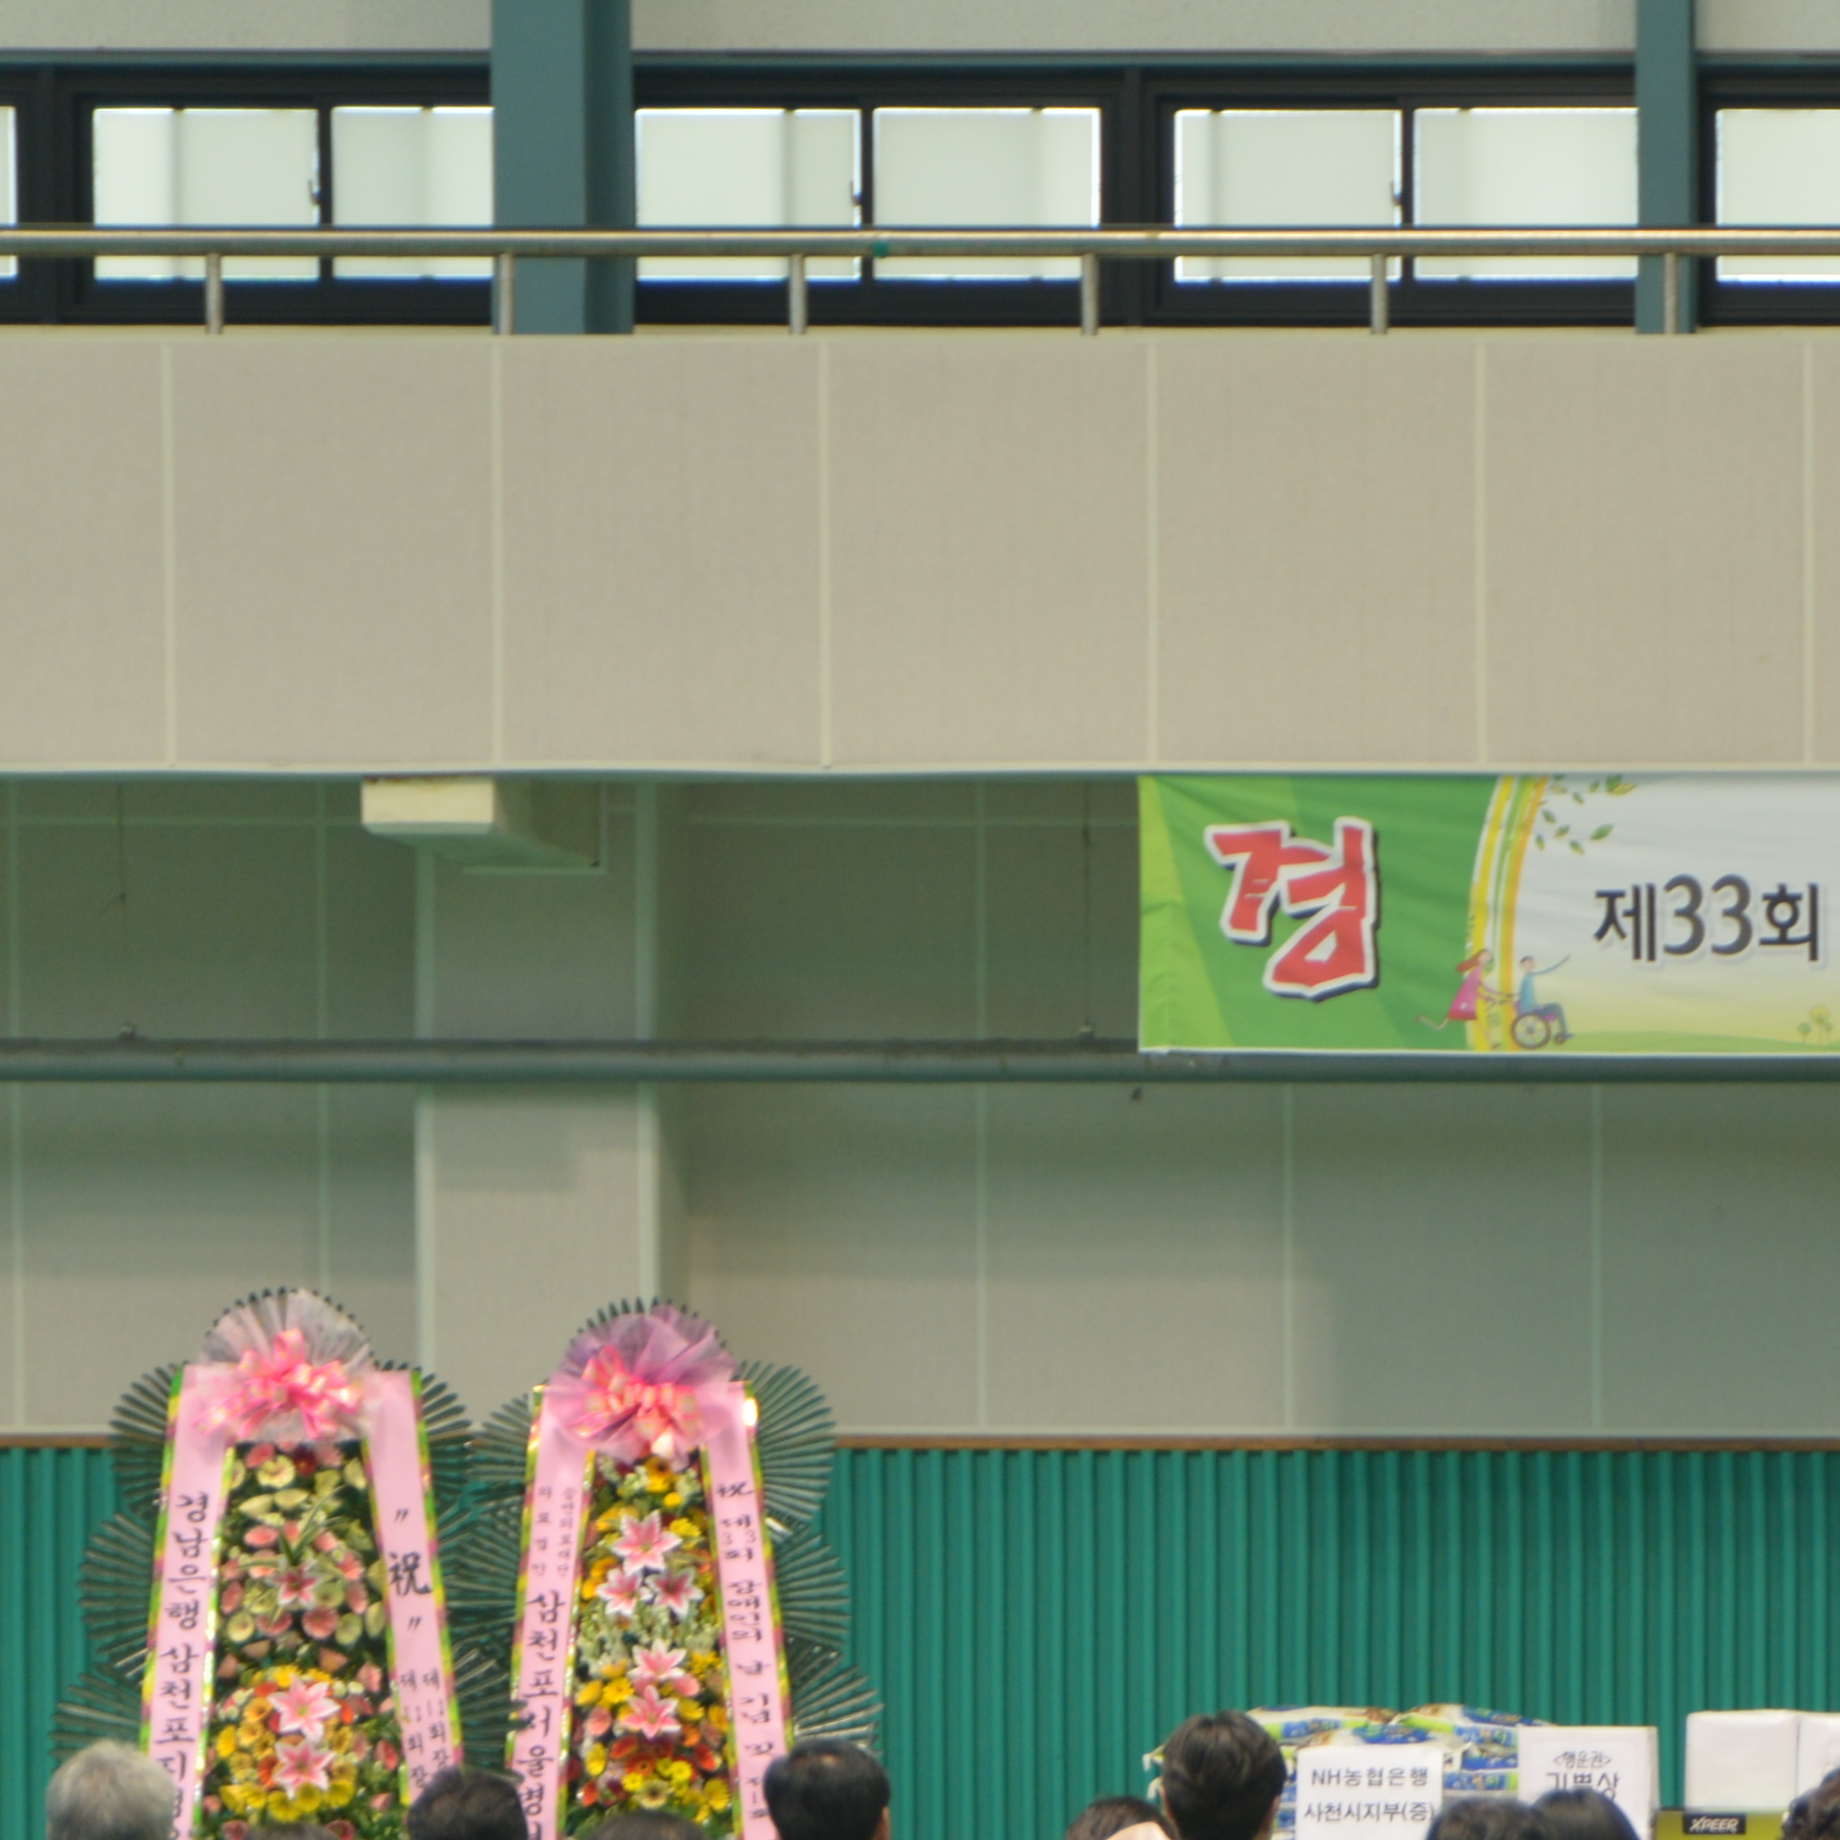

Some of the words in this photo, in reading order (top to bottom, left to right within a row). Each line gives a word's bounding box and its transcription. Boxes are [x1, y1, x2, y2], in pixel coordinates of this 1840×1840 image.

[1205, 817, 1377, 1000] 경
[1593, 872, 1821, 964] 제33회
[388, 1552, 432, 1596] 祝
[1304, 1801, 1436, 1823] 사천시지부(증)
[1689, 1815, 1739, 1834] XPEER
